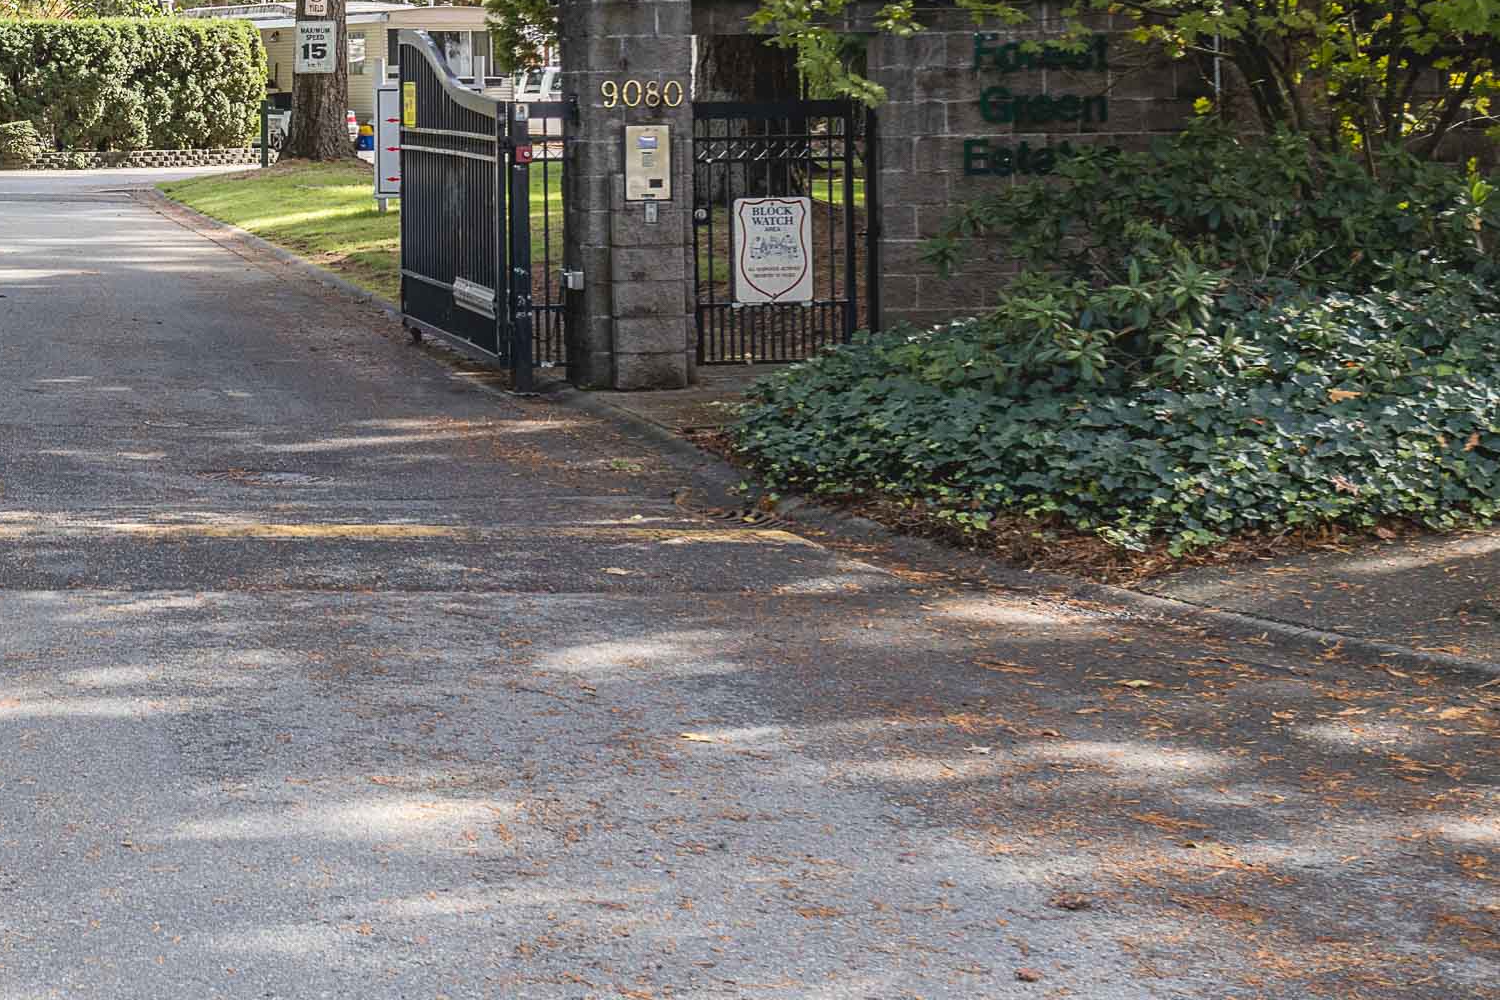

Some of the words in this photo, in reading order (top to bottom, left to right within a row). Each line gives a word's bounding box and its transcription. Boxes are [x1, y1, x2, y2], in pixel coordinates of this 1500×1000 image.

[301, 43, 327, 60] 15
[601, 80, 683, 107] 9080
[980, 86, 1109, 122] Green
[752, 206, 793, 216] BLOCK
[752, 216, 794, 226] WATCH
